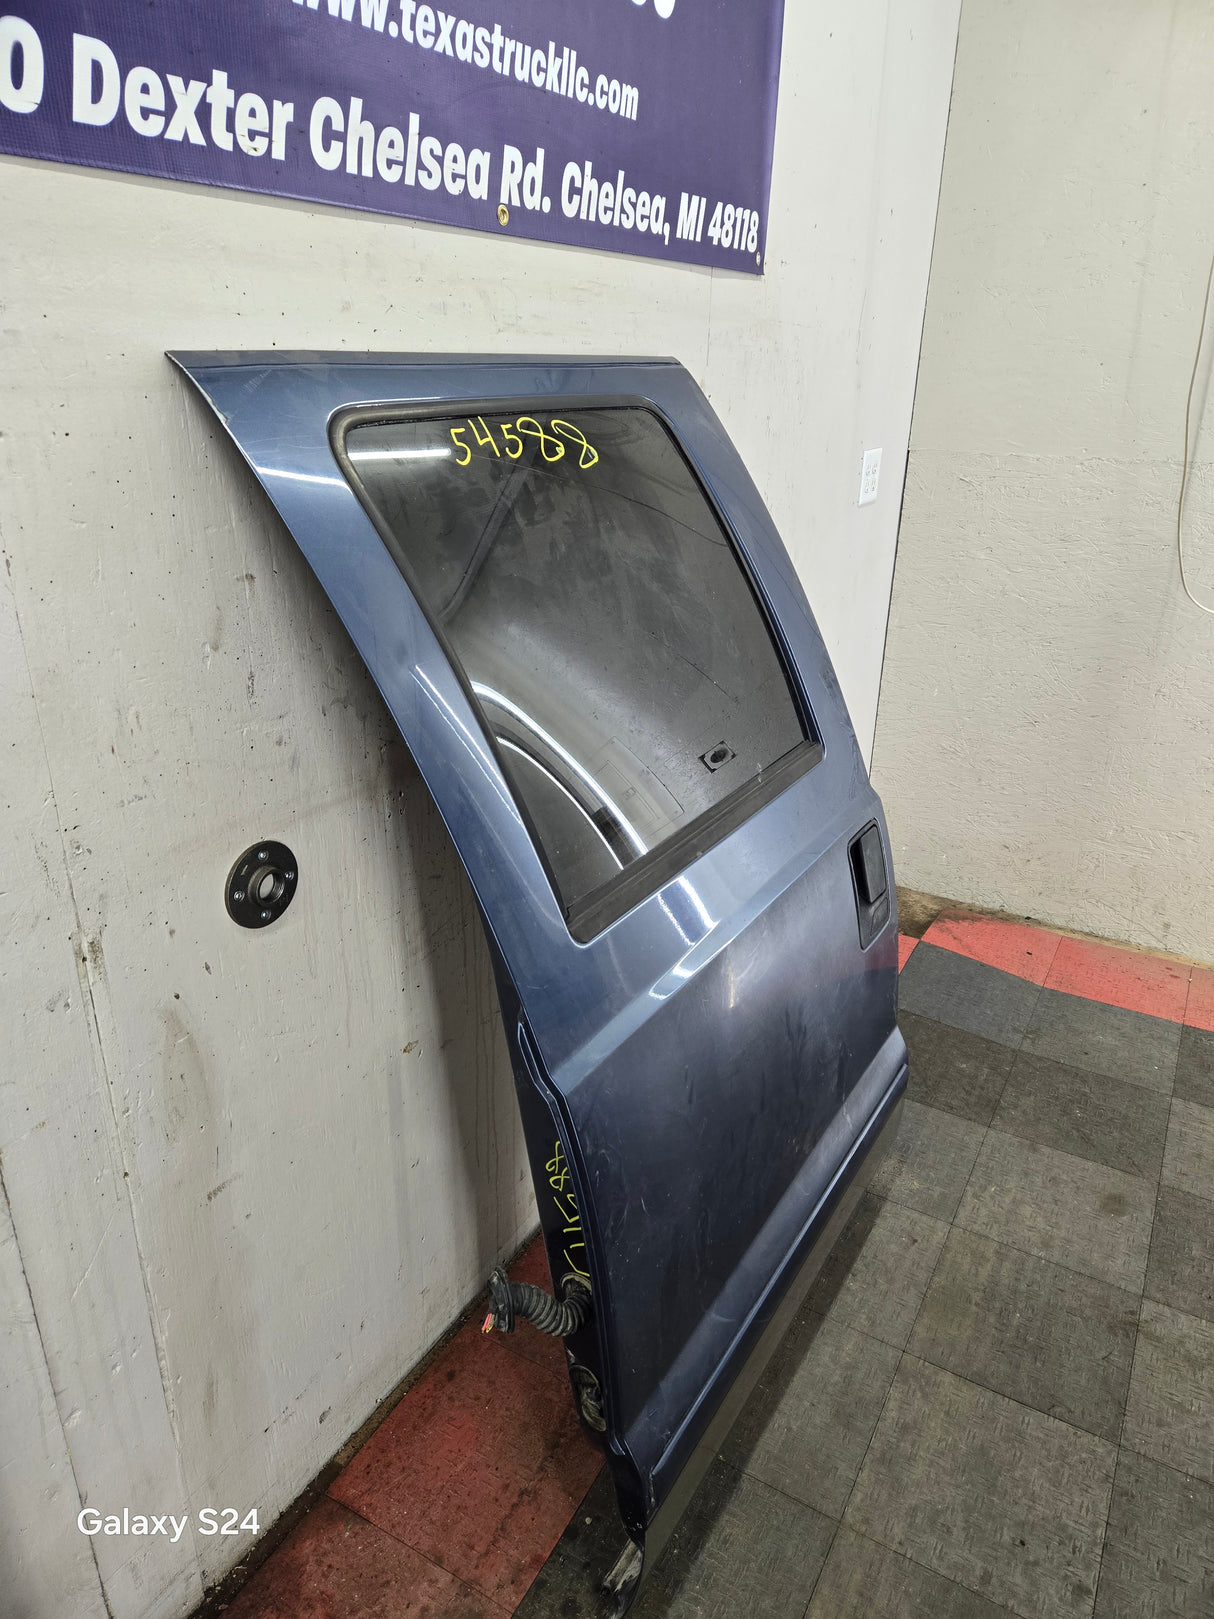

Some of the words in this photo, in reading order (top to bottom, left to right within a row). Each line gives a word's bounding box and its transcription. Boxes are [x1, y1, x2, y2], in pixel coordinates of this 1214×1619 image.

[291, 0, 639, 120] w.texastruckllc.com
[72, 33, 294, 161] Dexter
[309, 96, 491, 200] Chelsea
[500, 144, 551, 213] Rd.
[561, 161, 670, 245] Chelsea,
[676, 192, 707, 242] MI
[707, 201, 759, 252] 48118
[450, 415, 599, 469] 54588
